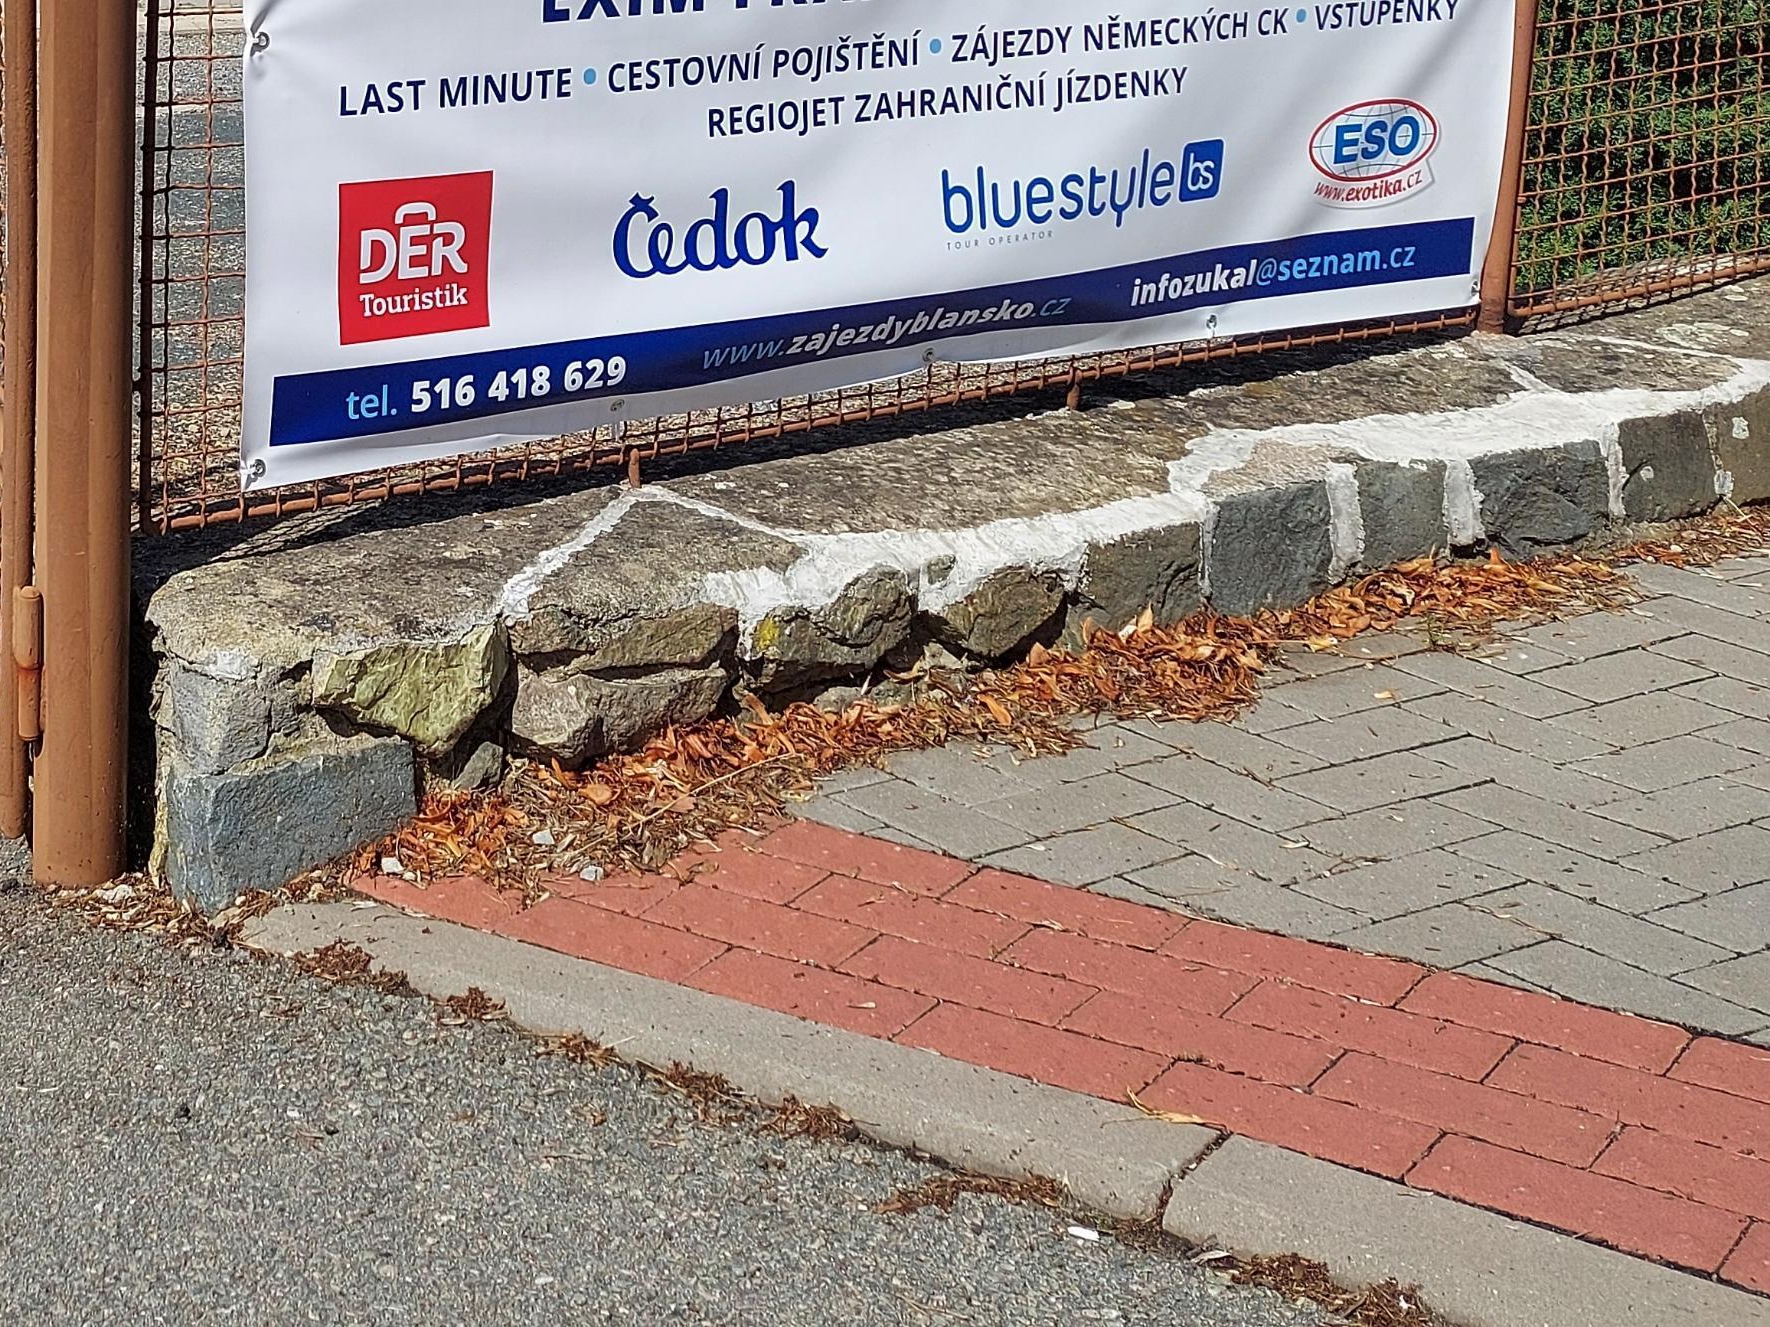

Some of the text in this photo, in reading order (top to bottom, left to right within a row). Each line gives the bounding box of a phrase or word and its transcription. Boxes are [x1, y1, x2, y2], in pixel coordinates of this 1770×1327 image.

[339, 78, 427, 117] LAST
[438, 67, 573, 109] MINUTE
[608, 43, 765, 93] CESTOVNÍ
[772, 29, 922, 85] POJIŠTĚNÍ
[951, 25, 1073, 66] ZÁJEZDY
[1083, 6, 1249, 52] NĚMECKÝCH
[1257, 7, 1290, 37] CK
[708, 66, 1189, 139] REGIOJET ZAHRANIČNÍ JÍZDENKY
[1186, 152, 1216, 191] bs
[1333, 115, 1421, 165] ESO
[941, 148, 1175, 234] bluestyle
[1313, 169, 1423, 203] www.exotika.cz
[359, 212, 469, 285] DER
[612, 179, 829, 280] Čedok
[947, 229, 1055, 251] TOUR OPERATOR
[359, 284, 469, 318] Touristik
[1130, 243, 1417, 307] infozukal@seznam.cz
[702, 293, 1071, 370] www.zajezdyblansko.cz
[345, 355, 627, 420] tel. 516 418 629
